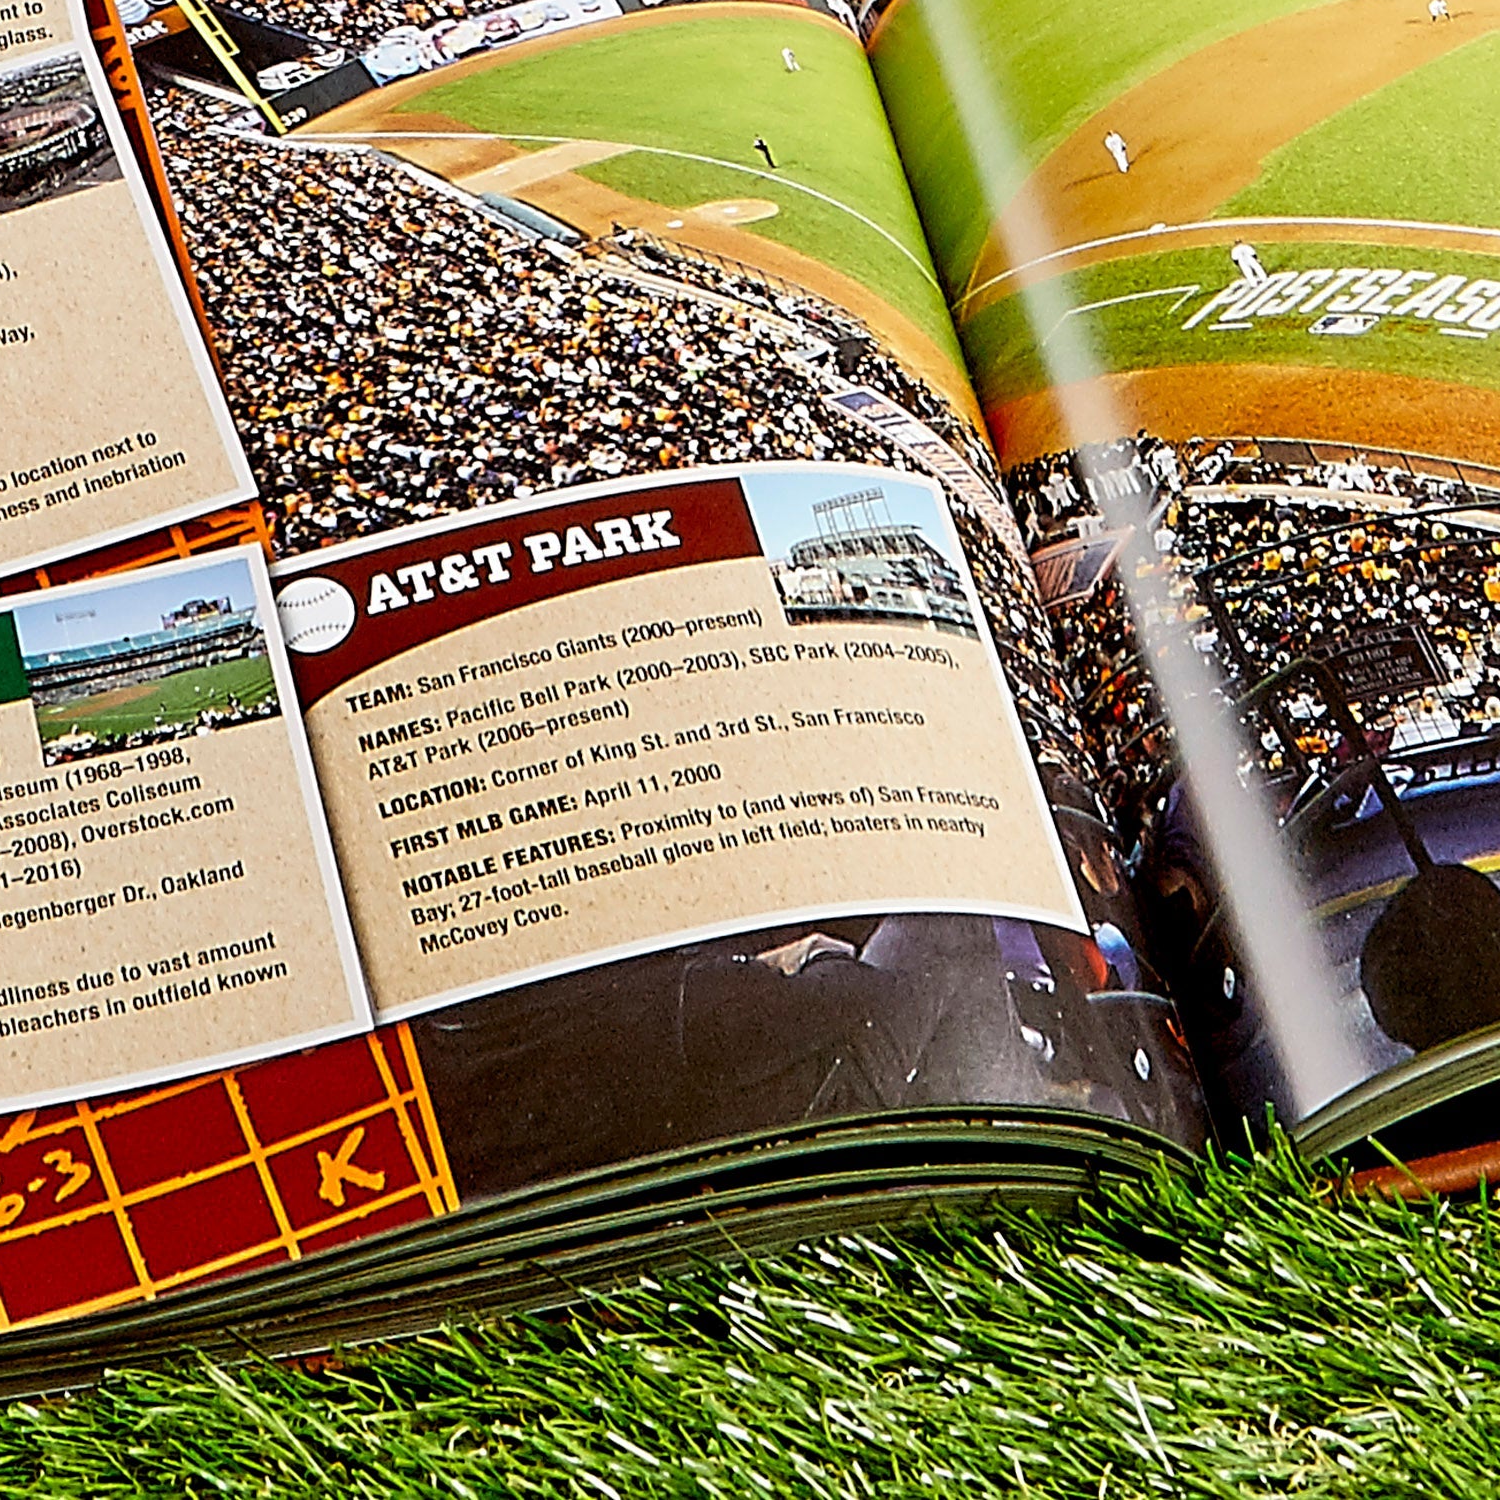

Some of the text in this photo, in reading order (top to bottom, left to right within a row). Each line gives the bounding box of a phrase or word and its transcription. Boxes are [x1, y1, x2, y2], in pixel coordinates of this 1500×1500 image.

[367, 510, 681, 615] AT&T PARK
[344, 682, 414, 714] TEAM:
[416, 673, 456, 695] San
[458, 648, 553, 684] Francisco
[555, 633, 618, 659] Giants
[378, 708, 925, 820] LOCATION: Corner of King St. and 3rd St., San Francisco
[389, 763, 723, 860] FIRST MLB GAME: April 11, 2000
[122, 885, 158, 904] Dr.,
[160, 859, 245, 895] Oakland
[419, 903, 570, 955] McCovey Cove.
[316, 1128, 386, 1200] K
